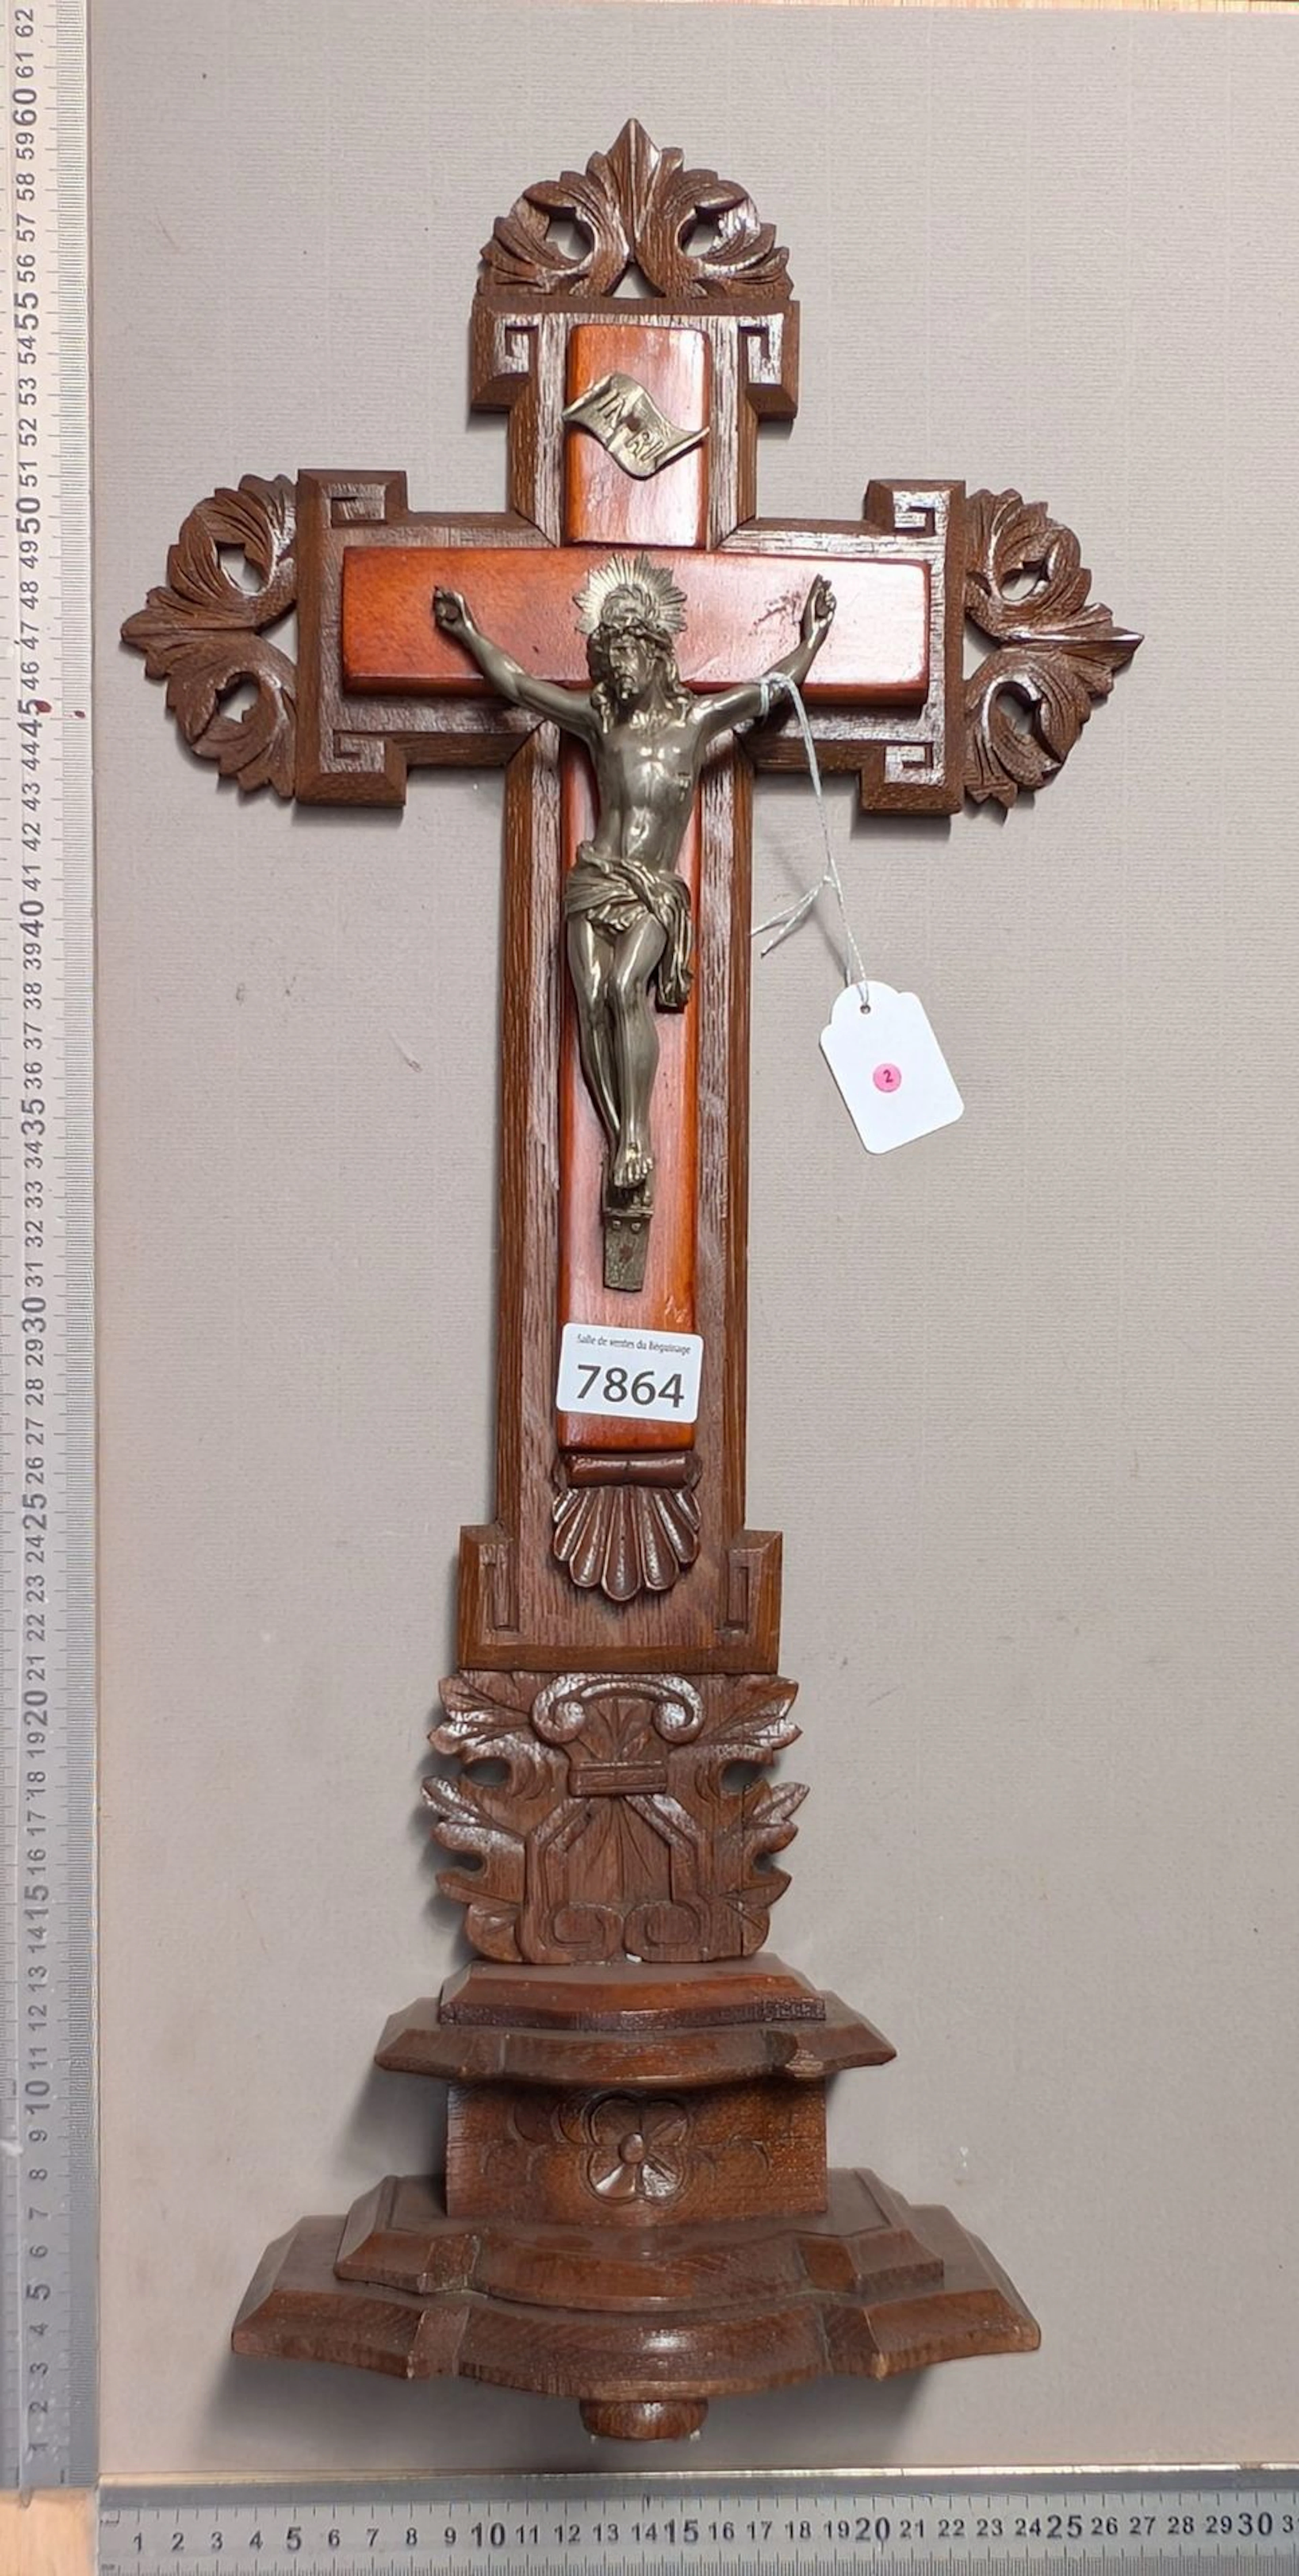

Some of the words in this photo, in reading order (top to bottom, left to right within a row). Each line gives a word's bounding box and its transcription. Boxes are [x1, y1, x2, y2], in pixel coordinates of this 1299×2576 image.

[14, 9, 33, 38] 62
[14, 52, 34, 78] 61
[11, 88, 37, 126] 60
[15, 132, 35, 160] 59
[15, 173, 35, 202] 58
[16, 213, 36, 242] 57
[16, 254, 36, 283] 56
[13, 292, 39, 332] 55
[17, 335, 36, 365] 54
[18, 377, 37, 405] 53
[19, 418, 37, 446] 52
[19, 461, 37, 487] 51
[16, 497, 40, 534] 50
[19, 535, 39, 569] 49
[19, 581, 39, 610] 48
[20, 619, 39, 650] 47
[20, 662, 40, 691] 46
[21, 741, 40, 771] 44
[21, 782, 41, 812] 43
[21, 822, 41, 852] 42
[22, 865, 41, 891] 41
[19, 900, 44, 938] 40
[23, 942, 42, 970] 39
[23, 982, 42, 1010] 38
[23, 1022, 43, 1050] 37
[23, 1061, 43, 1090] 36
[883, 1070, 893, 1083] 2
[20, 1099, 45, 1136] 35
[24, 1141, 43, 1169] 34
[24, 1181, 43, 1209] 33
[24, 1220, 43, 1248] 32
[24, 1262, 43, 1287] 31
[21, 1297, 46, 1333] 30
[25, 1339, 44, 1367] 29
[598, 1336, 608, 1346] de
[637, 1340, 646, 1350] du
[25, 1378, 44, 1406] 28
[577, 1364, 685, 1408] 7864
[25, 1417, 44, 1445] 27
[25, 1457, 44, 1484] 26
[22, 1494, 47, 1530] 25
[25, 1535, 44, 1563] 24
[25, 1575, 45, 1602] 23
[25, 1614, 45, 1641] 22
[25, 1656, 45, 1681] 21
[22, 1691, 48, 1726] 20
[26, 1732, 45, 1758] 19
[26, 1771, 45, 1797] 18
[27, 1810, 45, 1836] 17
[27, 1849, 46, 1875] 16
[23, 1885, 49, 1920] 15
[27, 1926, 46, 1953] 14
[28, 1966, 47, 1992] 13
[28, 2005, 46, 2031] 12
[29, 2048, 47, 2070] 11
[25, 2081, 49, 2115] 10
[29, 2130, 47, 2142] 9
[29, 2169, 47, 2180] 8
[29, 2207, 47, 2220] 7
[30, 2247, 47, 2258] 6
[26, 2285, 50, 2300] 5
[30, 2324, 47, 2336] 4
[30, 2363, 48, 2376] 3
[29, 2401, 48, 2416] 2
[28, 2443, 47, 2452] 1
[134, 2533, 142, 2552] 1
[172, 2533, 184, 2552] 2
[211, 2532, 223, 2551] 3
[249, 2531, 263, 2550] 4
[287, 2527, 302, 2552] 5
[328, 2529, 340, 2549] 6
[367, 2529, 379, 2547] 7
[406, 2528, 417, 2547] 8
[445, 2527, 456, 2547] 9
[471, 2522, 505, 2548] 10
[516, 2525, 538, 2545] 11
[554, 2525, 580, 2545] 12
[593, 2524, 619, 2543] 13
[632, 2523, 657, 2544] 14
[664, 2519, 699, 2545] 15
[709, 2522, 734, 2542] 16
[747, 2521, 772, 2542] 17
[785, 2521, 811, 2540] 18
[824, 2520, 849, 2540] 19
[855, 2517, 890, 2543] 20
[900, 2519, 924, 2539] 21
[938, 2519, 964, 2538] 22
[977, 2519, 1003, 2537] 23
[1015, 2518, 1041, 2537] 24
[1046, 2514, 1082, 2539] 25
[1091, 2516, 1118, 2536] 26
[1130, 2516, 1156, 2536] 27
[1168, 2516, 1194, 2535] 28
[1206, 2515, 1232, 2534] 29
[1238, 2512, 1273, 2537] 30
[1282, 2515, 1299, 2533] 3
